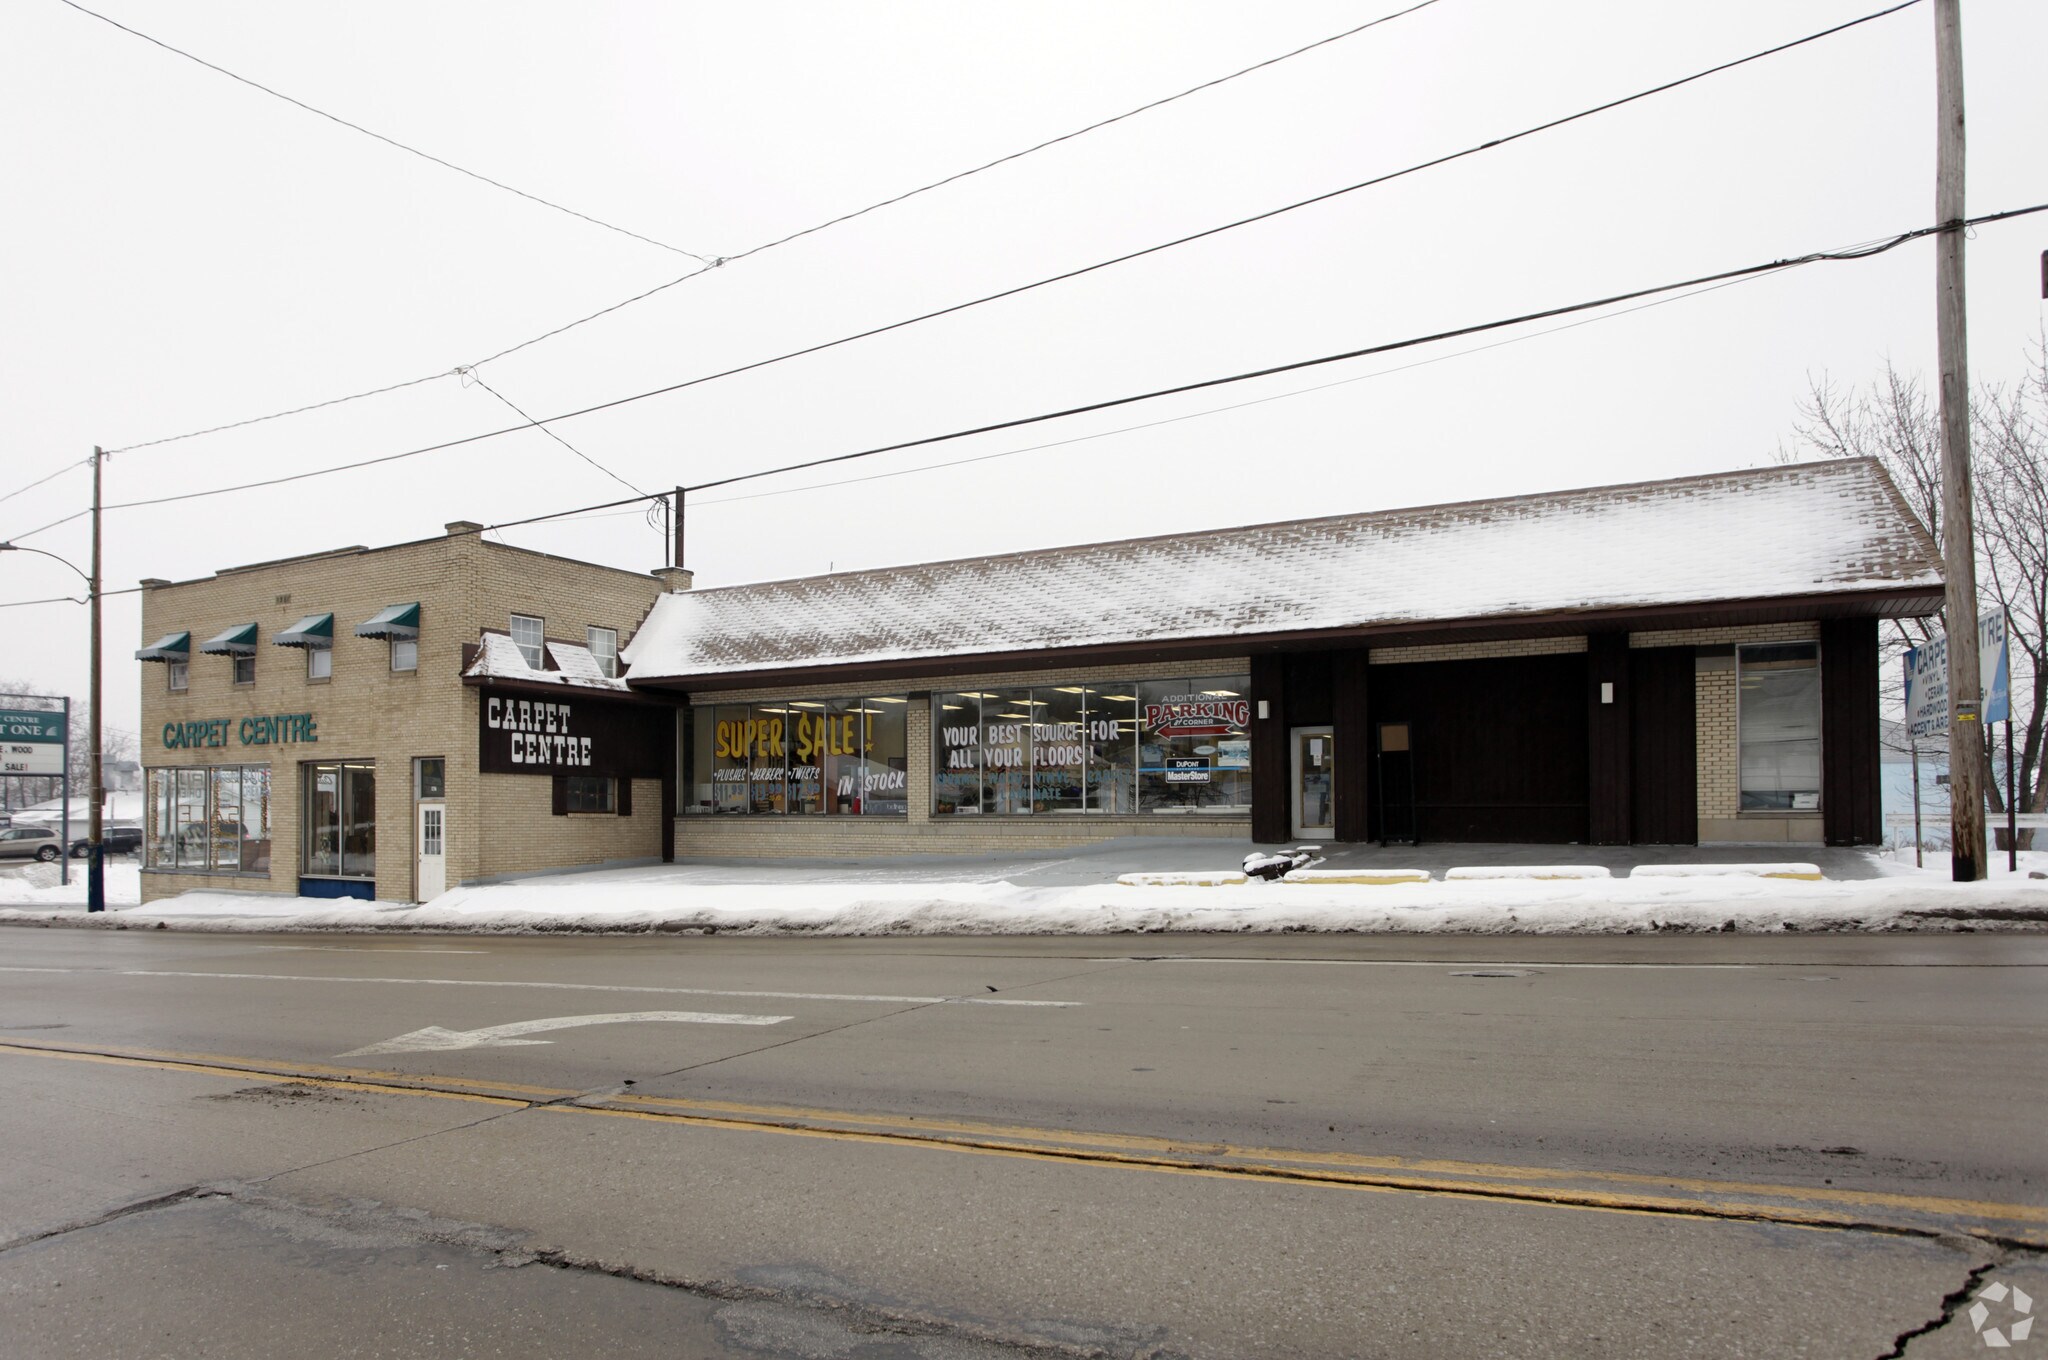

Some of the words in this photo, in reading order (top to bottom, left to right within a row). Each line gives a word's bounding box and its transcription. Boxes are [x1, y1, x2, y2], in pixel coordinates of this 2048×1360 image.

[1918, 639, 1946, 675] CARPE
[1978, 614, 2003, 648] TRE
[1161, 693, 1228, 703] ADDITIONAL
[4, 715, 40, 724] CENTRE
[488, 697, 571, 734] CARPET
[1145, 700, 1250, 729] PARKING
[1936, 715, 1948, 729] ARE
[10, 724, 43, 736] ONE
[162, 718, 231, 750] CARPET
[238, 712, 318, 746] CENTRE
[716, 717, 784, 759] SUPER
[943, 726, 978, 747] YOUR
[989, 724, 1022, 745] BEST
[1033, 723, 1078, 742] SOURCE
[1091, 720, 1119, 741] FOR
[12, 746, 33, 754] WOOD
[511, 733, 592, 766] CENTRE
[950, 750, 974, 769] ALL
[984, 747, 1023, 767] YOUR
[5, 763, 28, 771] SALE!
[716, 768, 747, 781] PLUSHES
[752, 767, 784, 780] BERBERS
[790, 767, 820, 780] TWISTS
[1167, 770, 1208, 781] MasterStore
[837, 777, 854, 797] IN
[864, 771, 905, 792] STOCK
